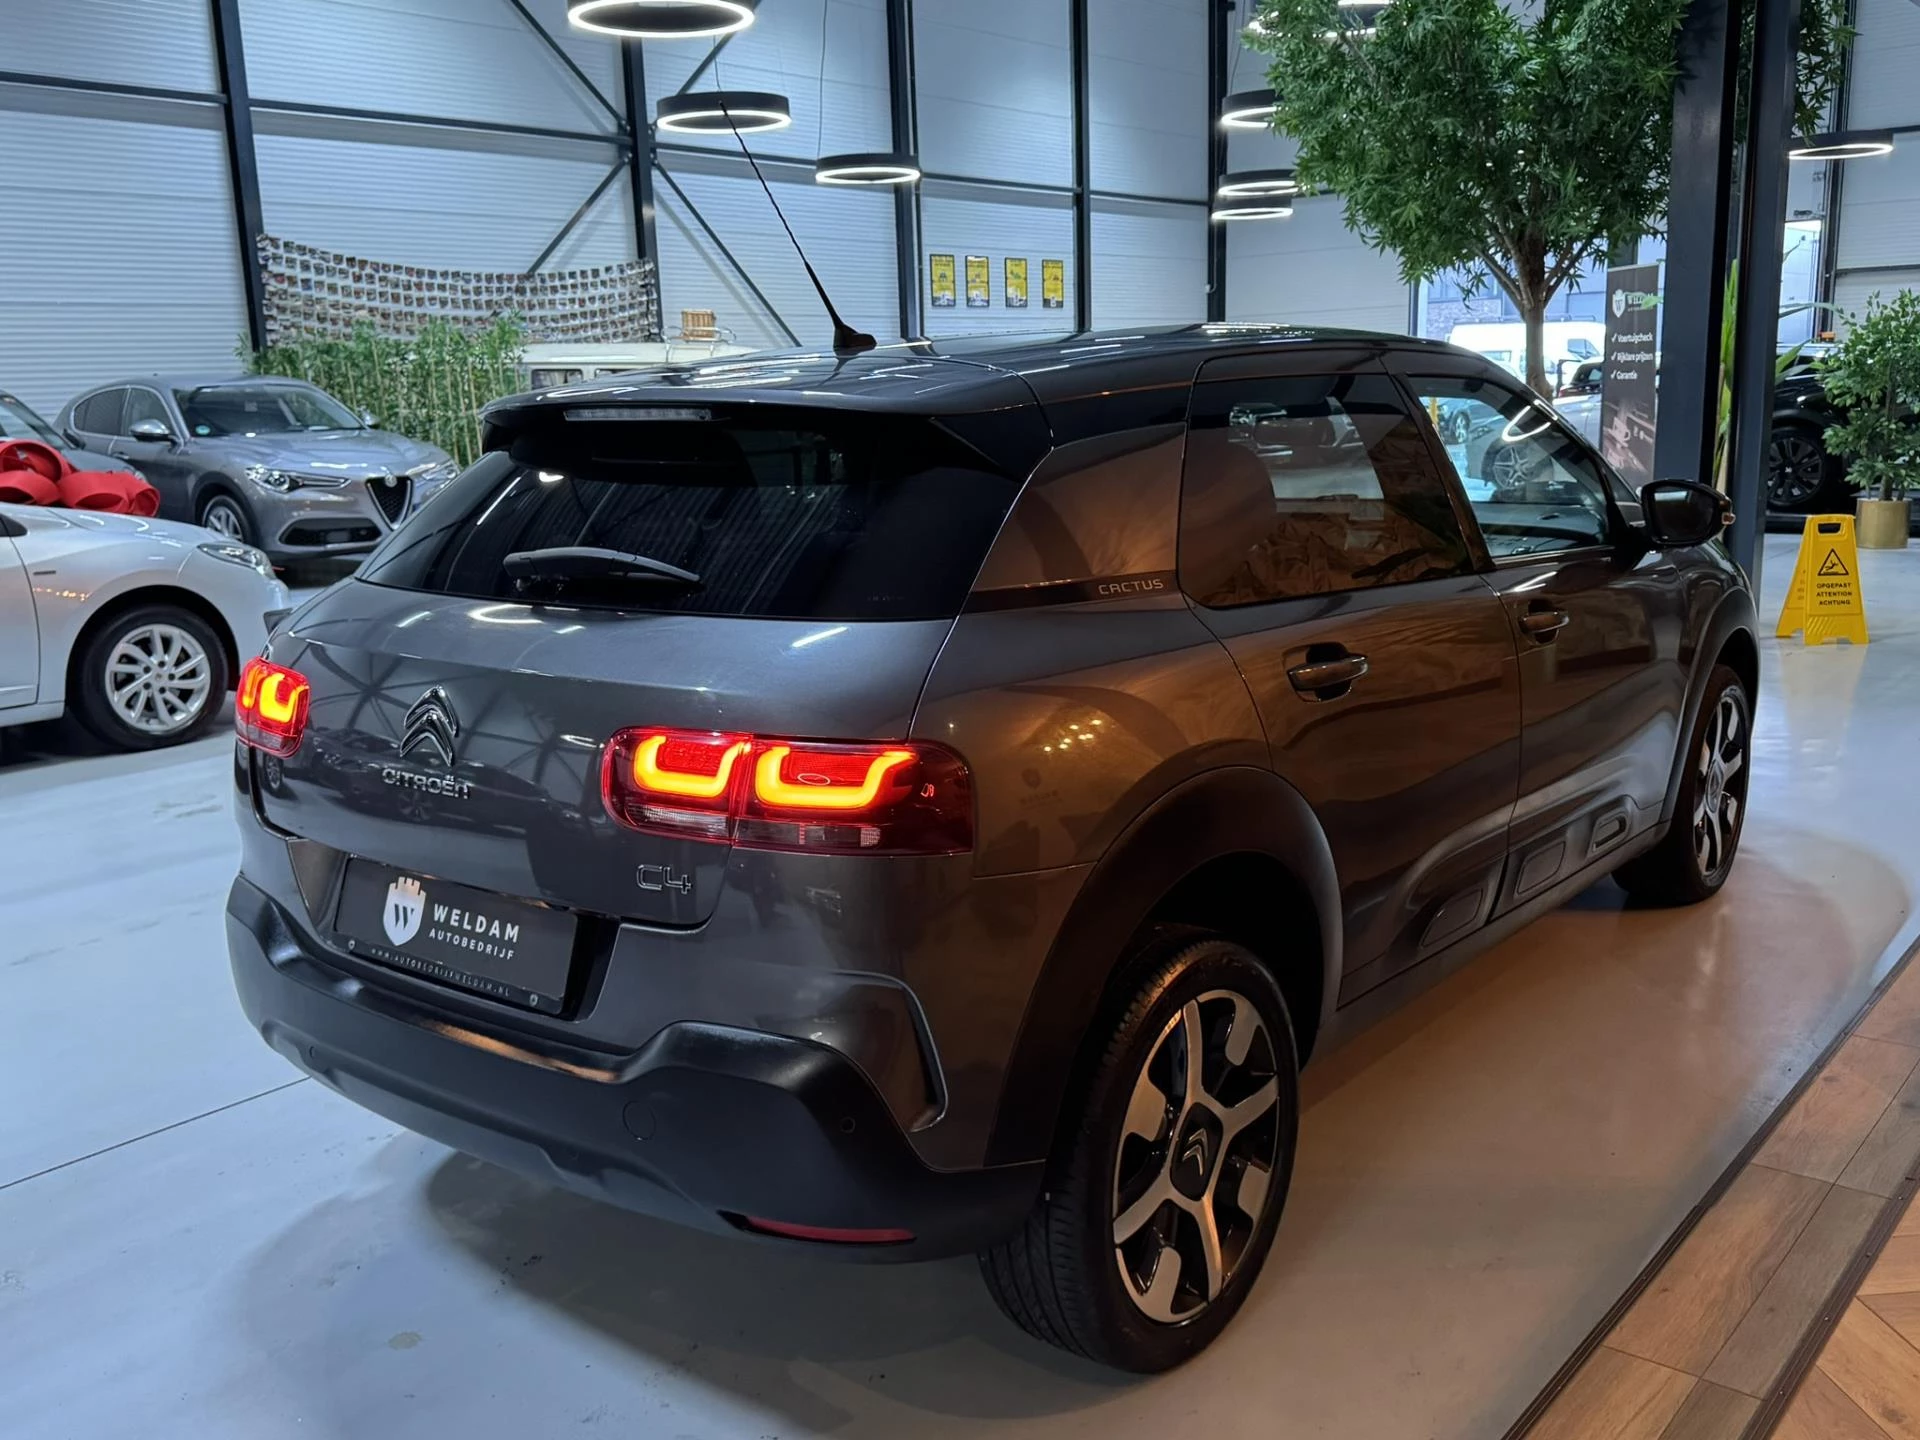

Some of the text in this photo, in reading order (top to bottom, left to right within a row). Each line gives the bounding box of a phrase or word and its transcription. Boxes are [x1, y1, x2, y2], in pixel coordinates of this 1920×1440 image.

[1616, 370, 1638, 380] Garantie
[1098, 579, 1164, 595] CACTUS
[636, 864, 692, 895] C4
[433, 903, 520, 944] WELDAM
[428, 927, 515, 961] AUTOBEDRIJF
